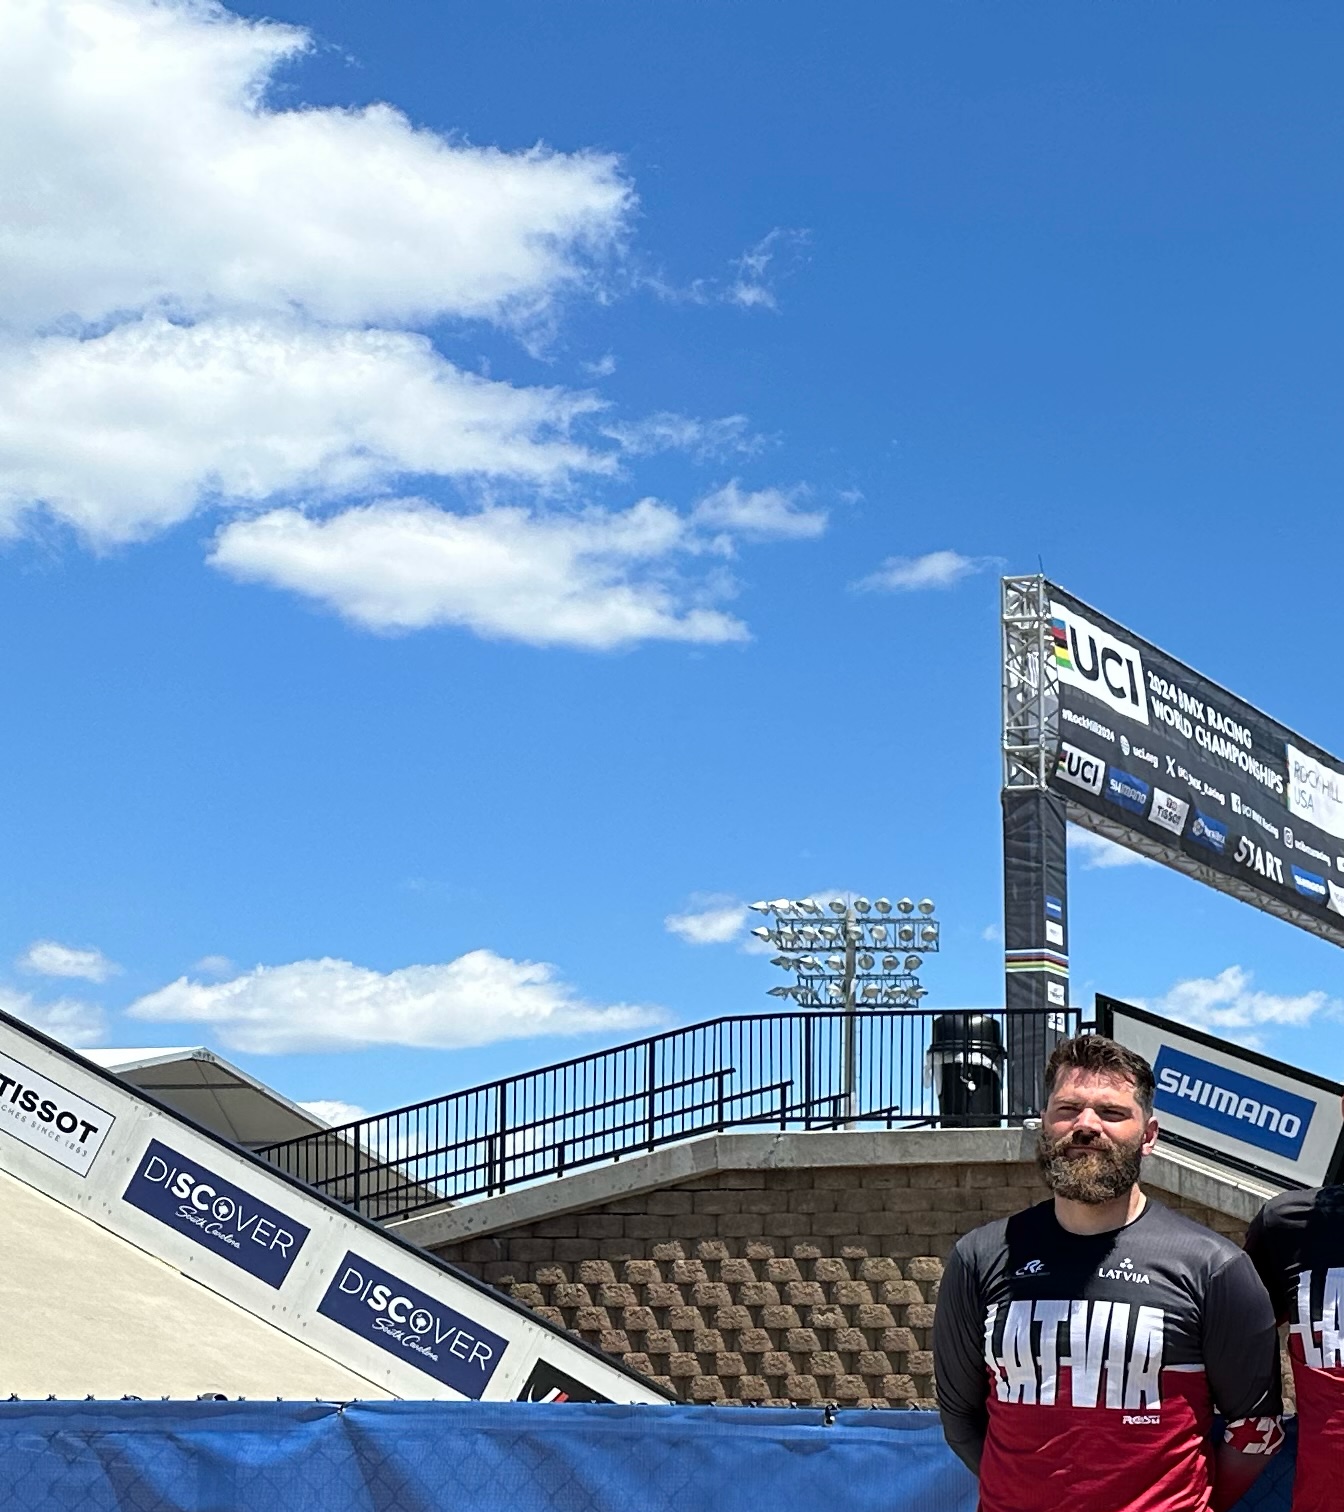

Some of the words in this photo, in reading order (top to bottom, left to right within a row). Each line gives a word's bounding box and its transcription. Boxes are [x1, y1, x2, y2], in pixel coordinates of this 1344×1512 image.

[1069, 625, 1140, 707] UCI
[1148, 671, 1177, 700] 2024
[1178, 688, 1206, 723] BMX
[1207, 706, 1252, 749] RACING
[1067, 752, 1099, 787] UCI
[1151, 696, 1192, 738] WORLD
[1195, 725, 1284, 794] CHAMPIONSHIPS
[1109, 778, 1147, 805] SHIMANO
[1294, 786, 1315, 813] USA
[1233, 835, 1284, 884] START
[0, 1073, 99, 1144] TISSOT
[31, 1121, 61, 1142] SINCE
[1156, 1066, 1302, 1139] SHIMANO
[143, 1156, 294, 1259] DISCOVER
[175, 1205, 208, 1229] South
[204, 1223, 241, 1249] Carolina
[1098, 1267, 1150, 1285] LATVIJA
[339, 1268, 493, 1371] DISCOVER
[372, 1317, 405, 1341] South
[402, 1335, 438, 1362] Carolina
[983, 1299, 1165, 1410] LATVIA
